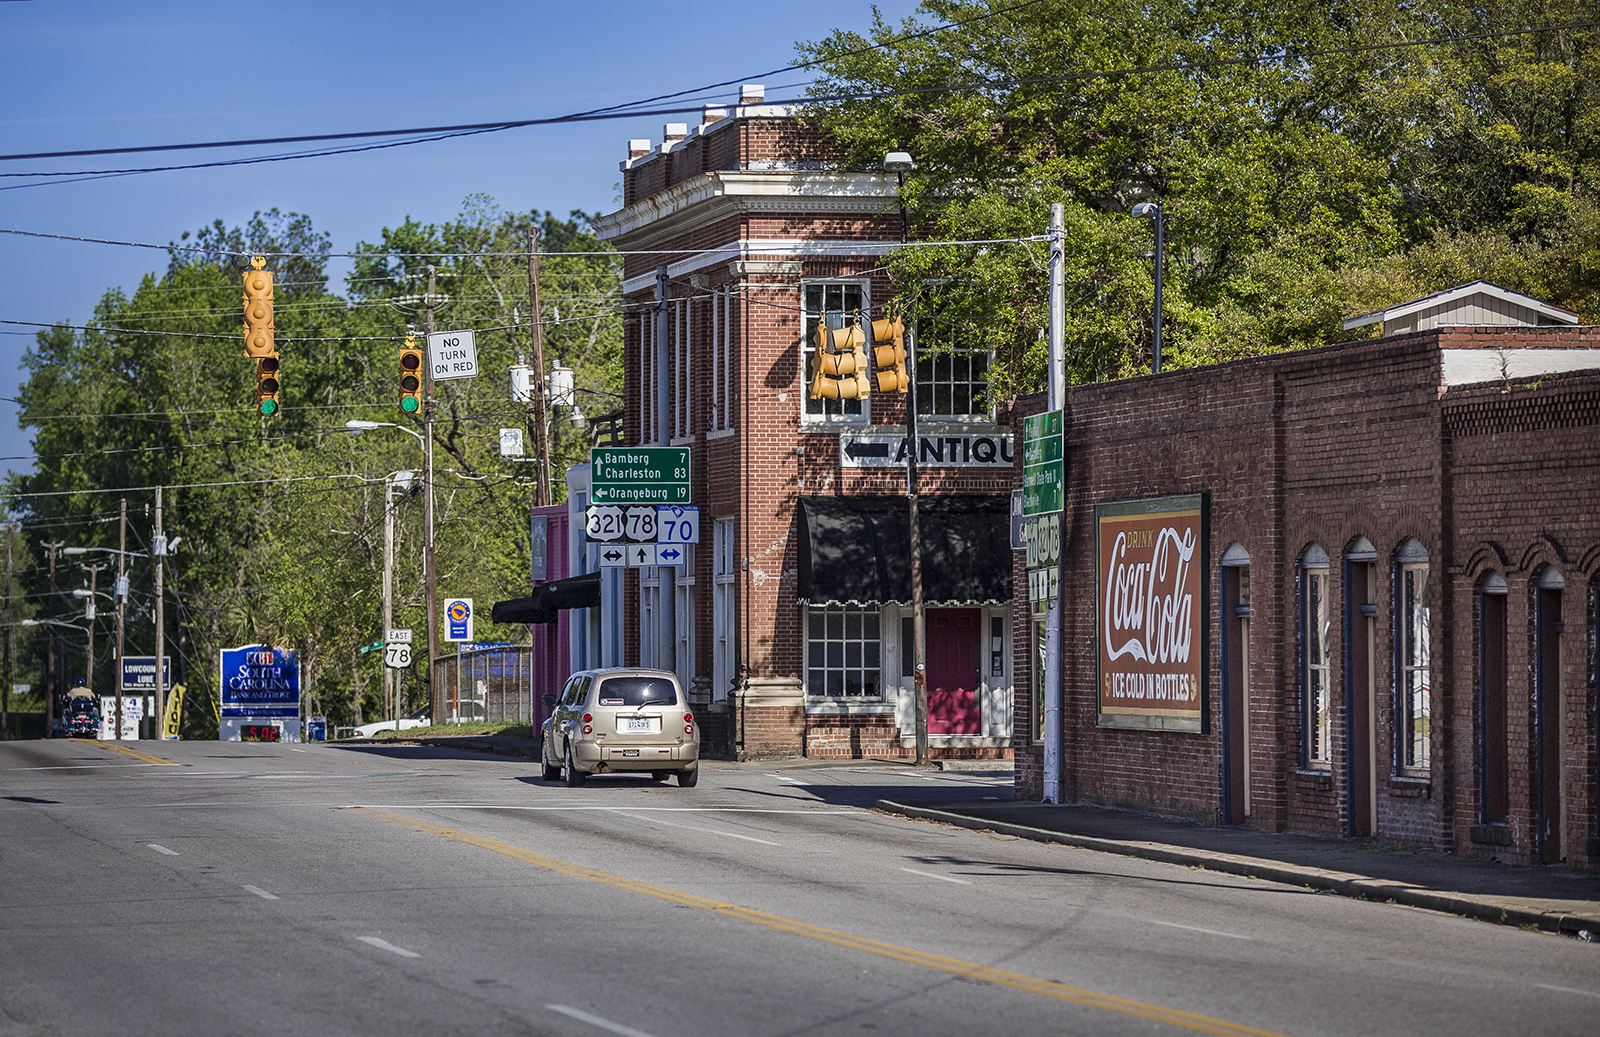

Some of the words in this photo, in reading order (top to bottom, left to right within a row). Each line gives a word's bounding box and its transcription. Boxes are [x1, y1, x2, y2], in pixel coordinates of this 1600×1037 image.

[443, 338, 460, 348] NO
[439, 350, 467, 361] TURN
[435, 364, 449, 374] ON
[453, 361, 474, 372] RED
[605, 453, 649, 466] Bamberg
[680, 453, 686, 464] 7
[605, 468, 661, 479] Charleston
[674, 468, 687, 479] 83
[609, 487, 668, 500] Orangeburg
[677, 487, 687, 498] 19
[590, 514, 621, 534] 321
[629, 514, 653, 534] 78
[664, 520, 693, 541] 70
[1039, 526, 1049, 554] 321
[1050, 525, 1058, 553] 78
[1127, 530, 1154, 549] DRINK
[1028, 536, 1036, 564] 70
[390, 630, 408, 640] EAST
[389, 649, 408, 664] 78
[125, 665, 167, 673] LOWCOUNY
[238, 665, 282, 679] SOUTH
[137, 675, 154, 683] LUBE
[229, 677, 291, 691] CAROLINA
[1112, 672, 1125, 698] ICE
[1126, 672, 1145, 700] COLD
[1146, 673, 1154, 699] IN
[1155, 673, 1189, 702] BOTTLES
